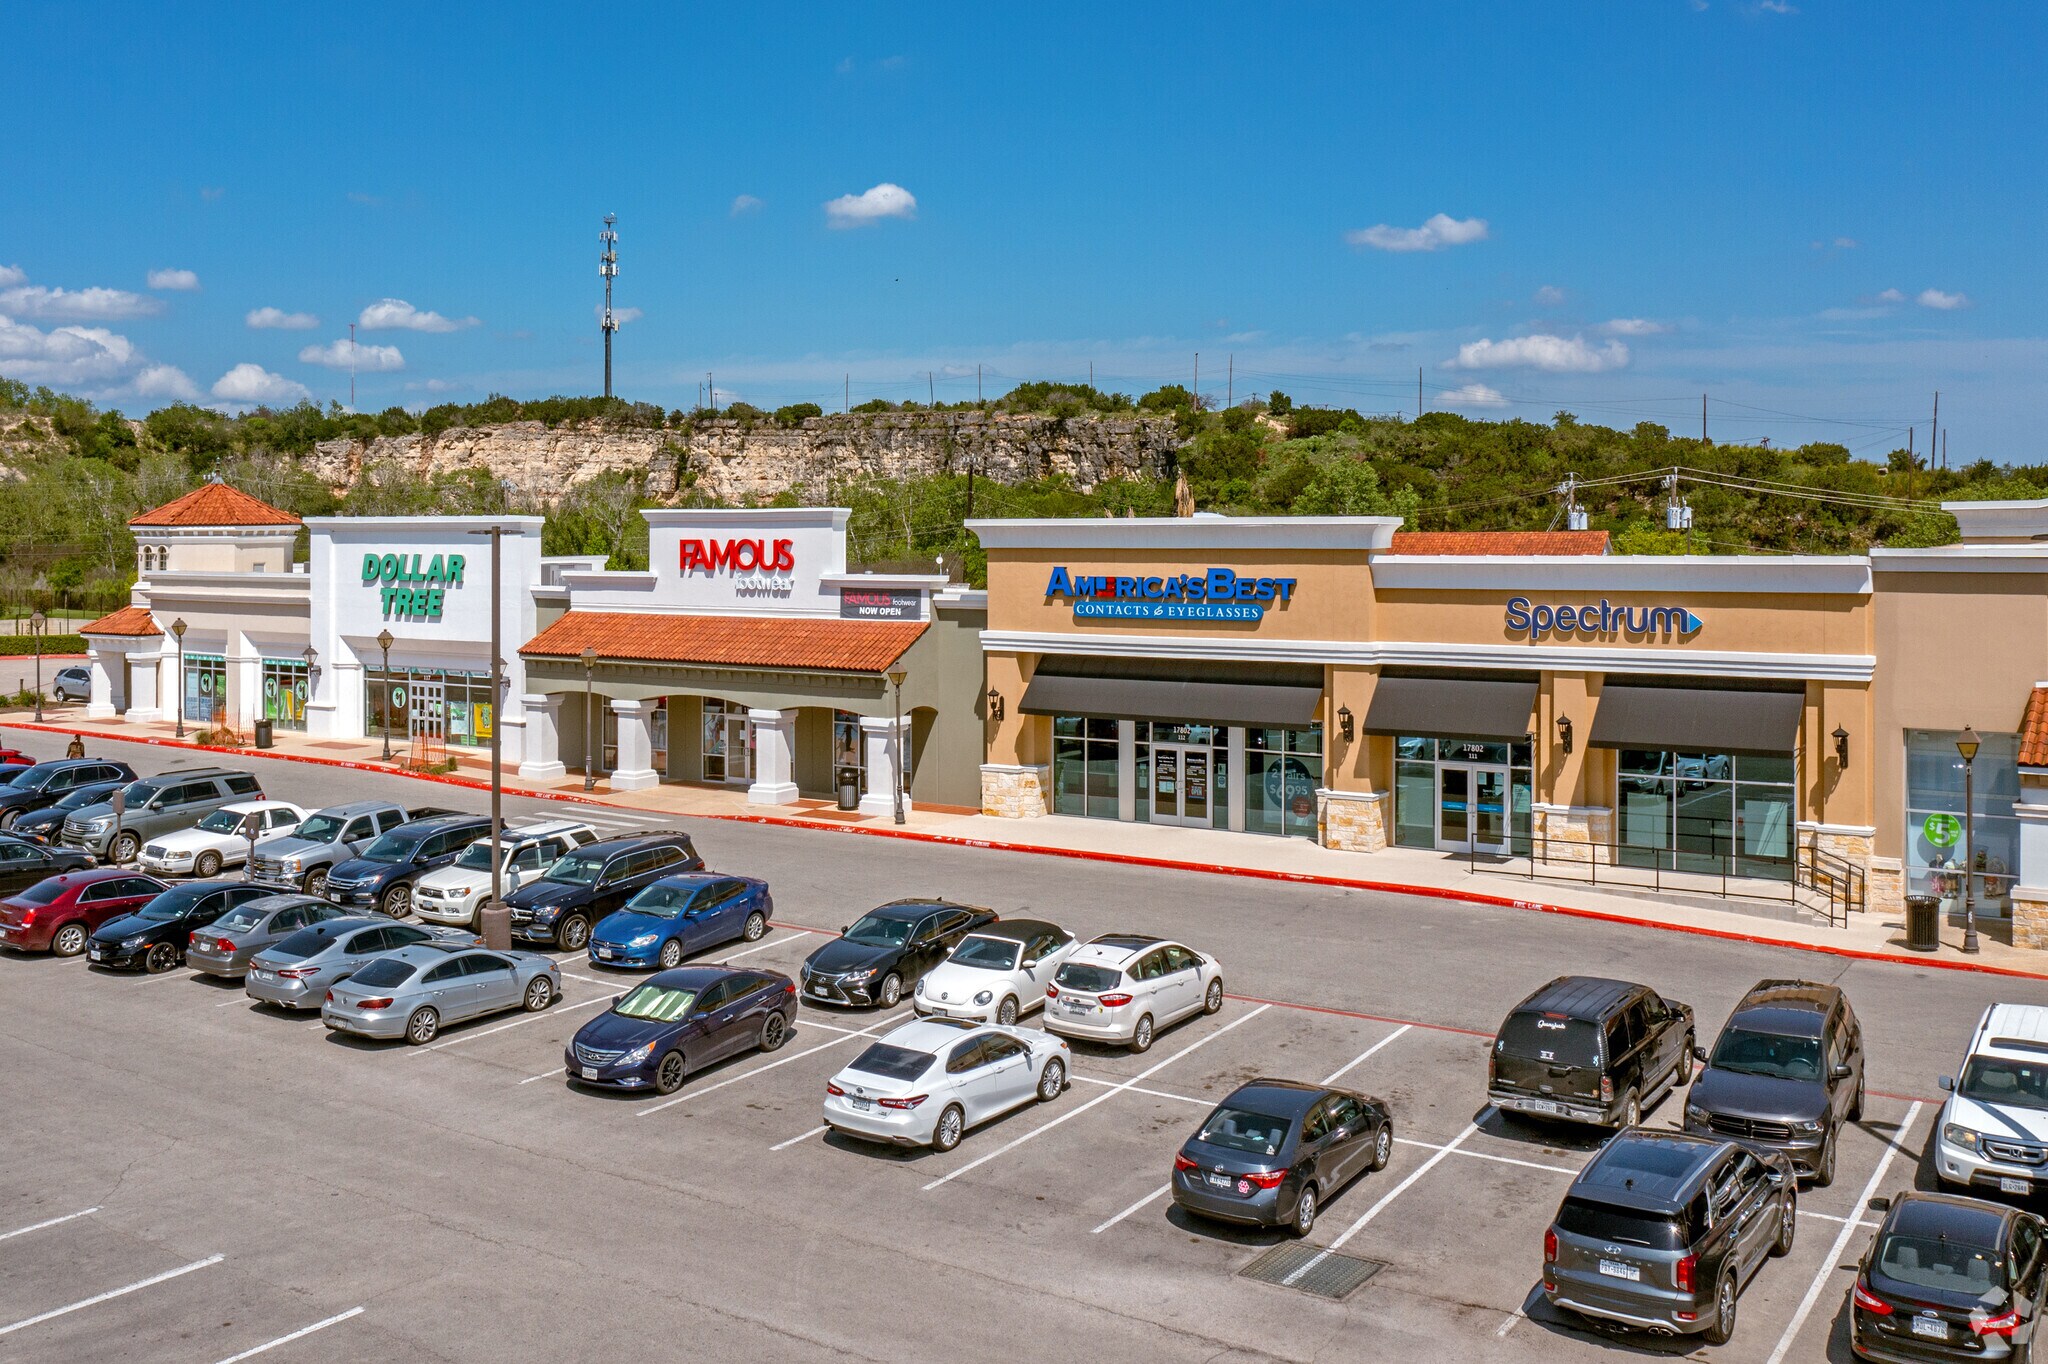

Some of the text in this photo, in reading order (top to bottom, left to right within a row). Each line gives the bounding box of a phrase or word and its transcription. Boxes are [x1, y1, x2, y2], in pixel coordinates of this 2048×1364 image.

[679, 538, 795, 571] FAMOUS
[361, 552, 466, 582] DOLLAR
[735, 573, 795, 591] footwear
[380, 587, 445, 616] TREE
[843, 591, 917, 607] FAMOUS footwear
[859, 607, 901, 616] NOW OPEN
[1076, 604, 1149, 616] CONTACTS
[1168, 607, 1259, 619] EYEGLASSES
[1506, 597, 1690, 639] Spectrum
[1173, 726, 1191, 735] 17802
[1462, 743, 1484, 753] 17802
